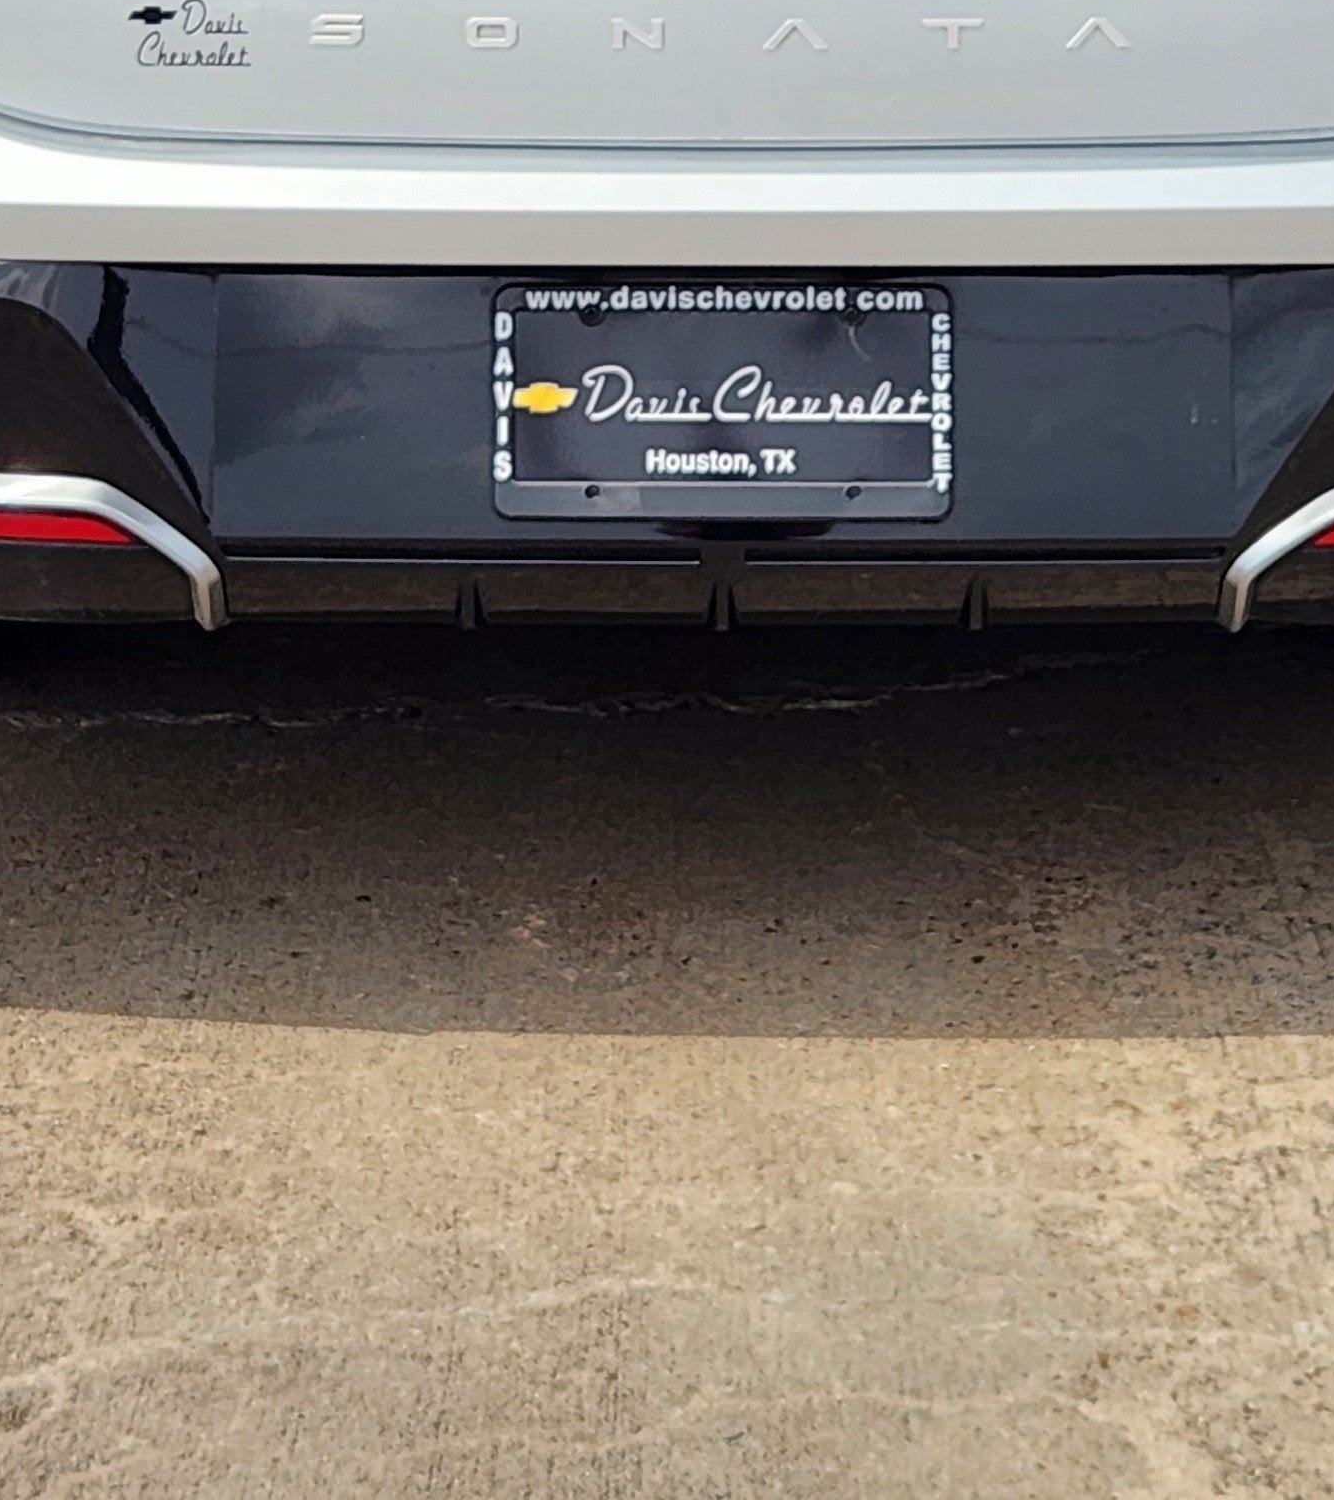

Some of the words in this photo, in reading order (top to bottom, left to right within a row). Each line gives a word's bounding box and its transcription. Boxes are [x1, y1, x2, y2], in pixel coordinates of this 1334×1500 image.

[137, 31, 253, 67] Chevrolet
[309, 12, 1133, 50] SONATA
[525, 285, 924, 311] www.davischevroletcom
[493, 311, 515, 482] DAVIS
[581, 365, 713, 422] Davis
[712, 365, 933, 422] Chevrolet
[931, 312, 953, 493] CHEVROLET
[645, 448, 758, 478] Houston,
[760, 449, 798, 475] TX
